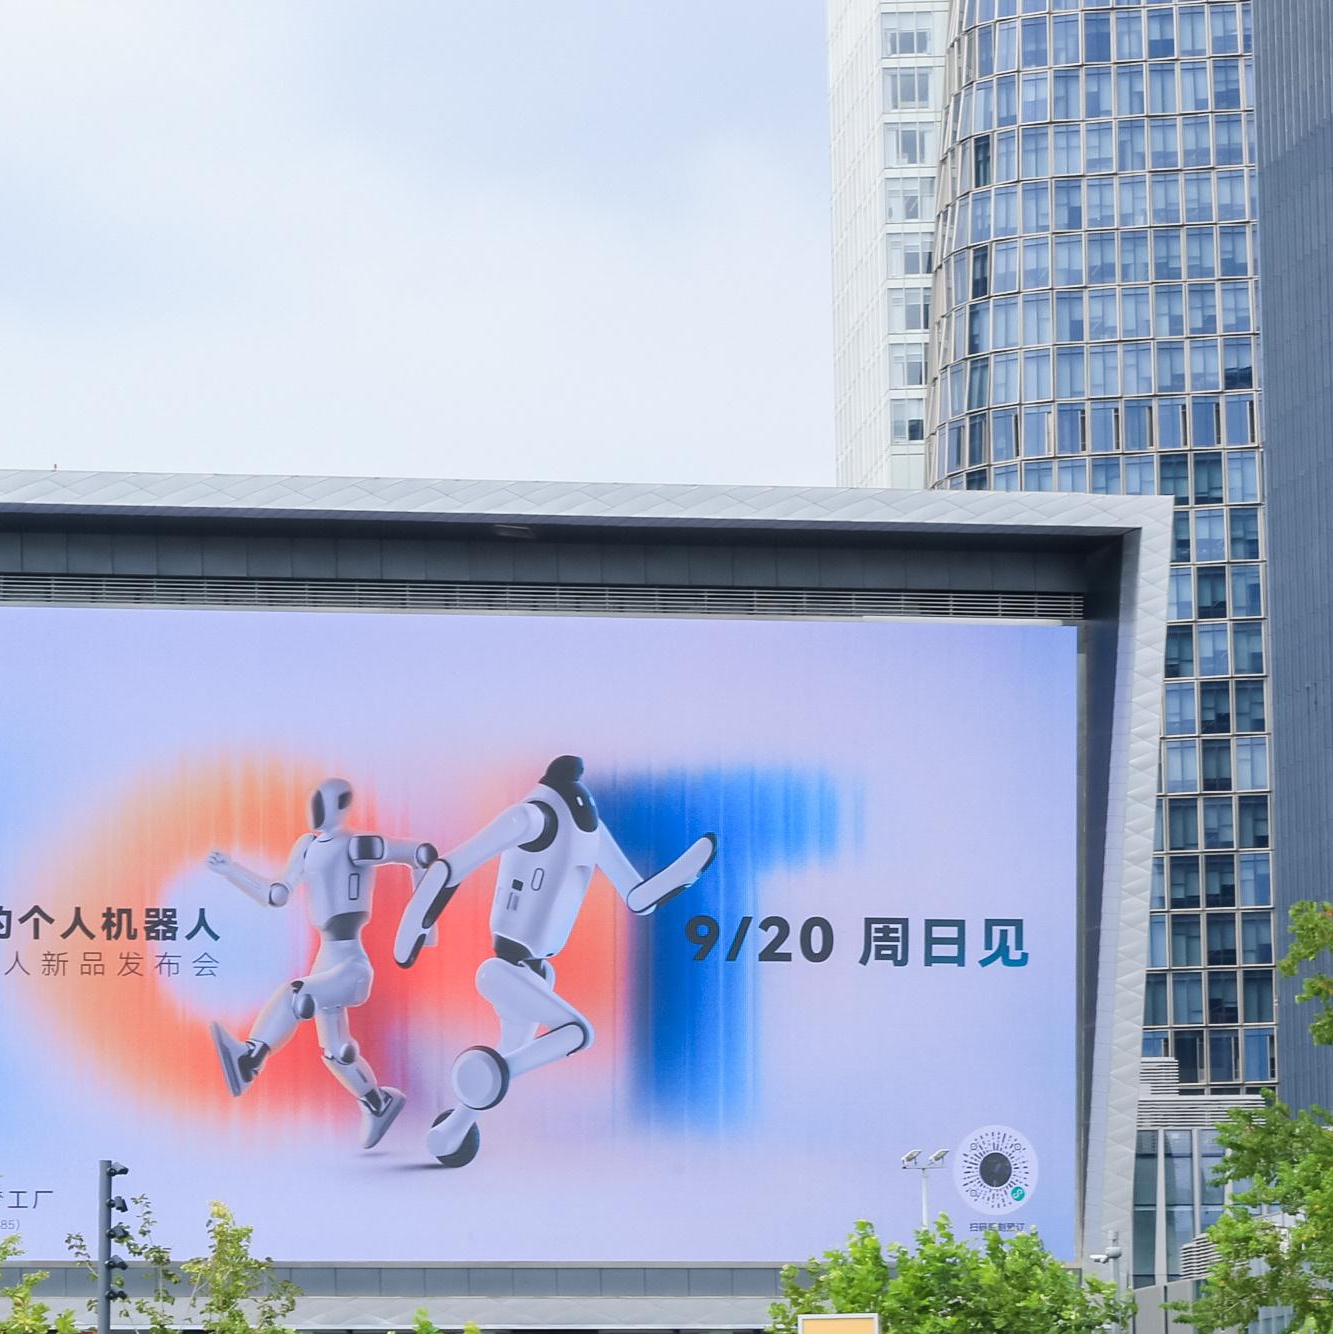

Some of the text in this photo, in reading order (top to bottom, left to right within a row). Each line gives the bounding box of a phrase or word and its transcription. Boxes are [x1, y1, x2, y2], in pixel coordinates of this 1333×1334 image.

[685, 915, 1030, 968] 9/20 周日见
